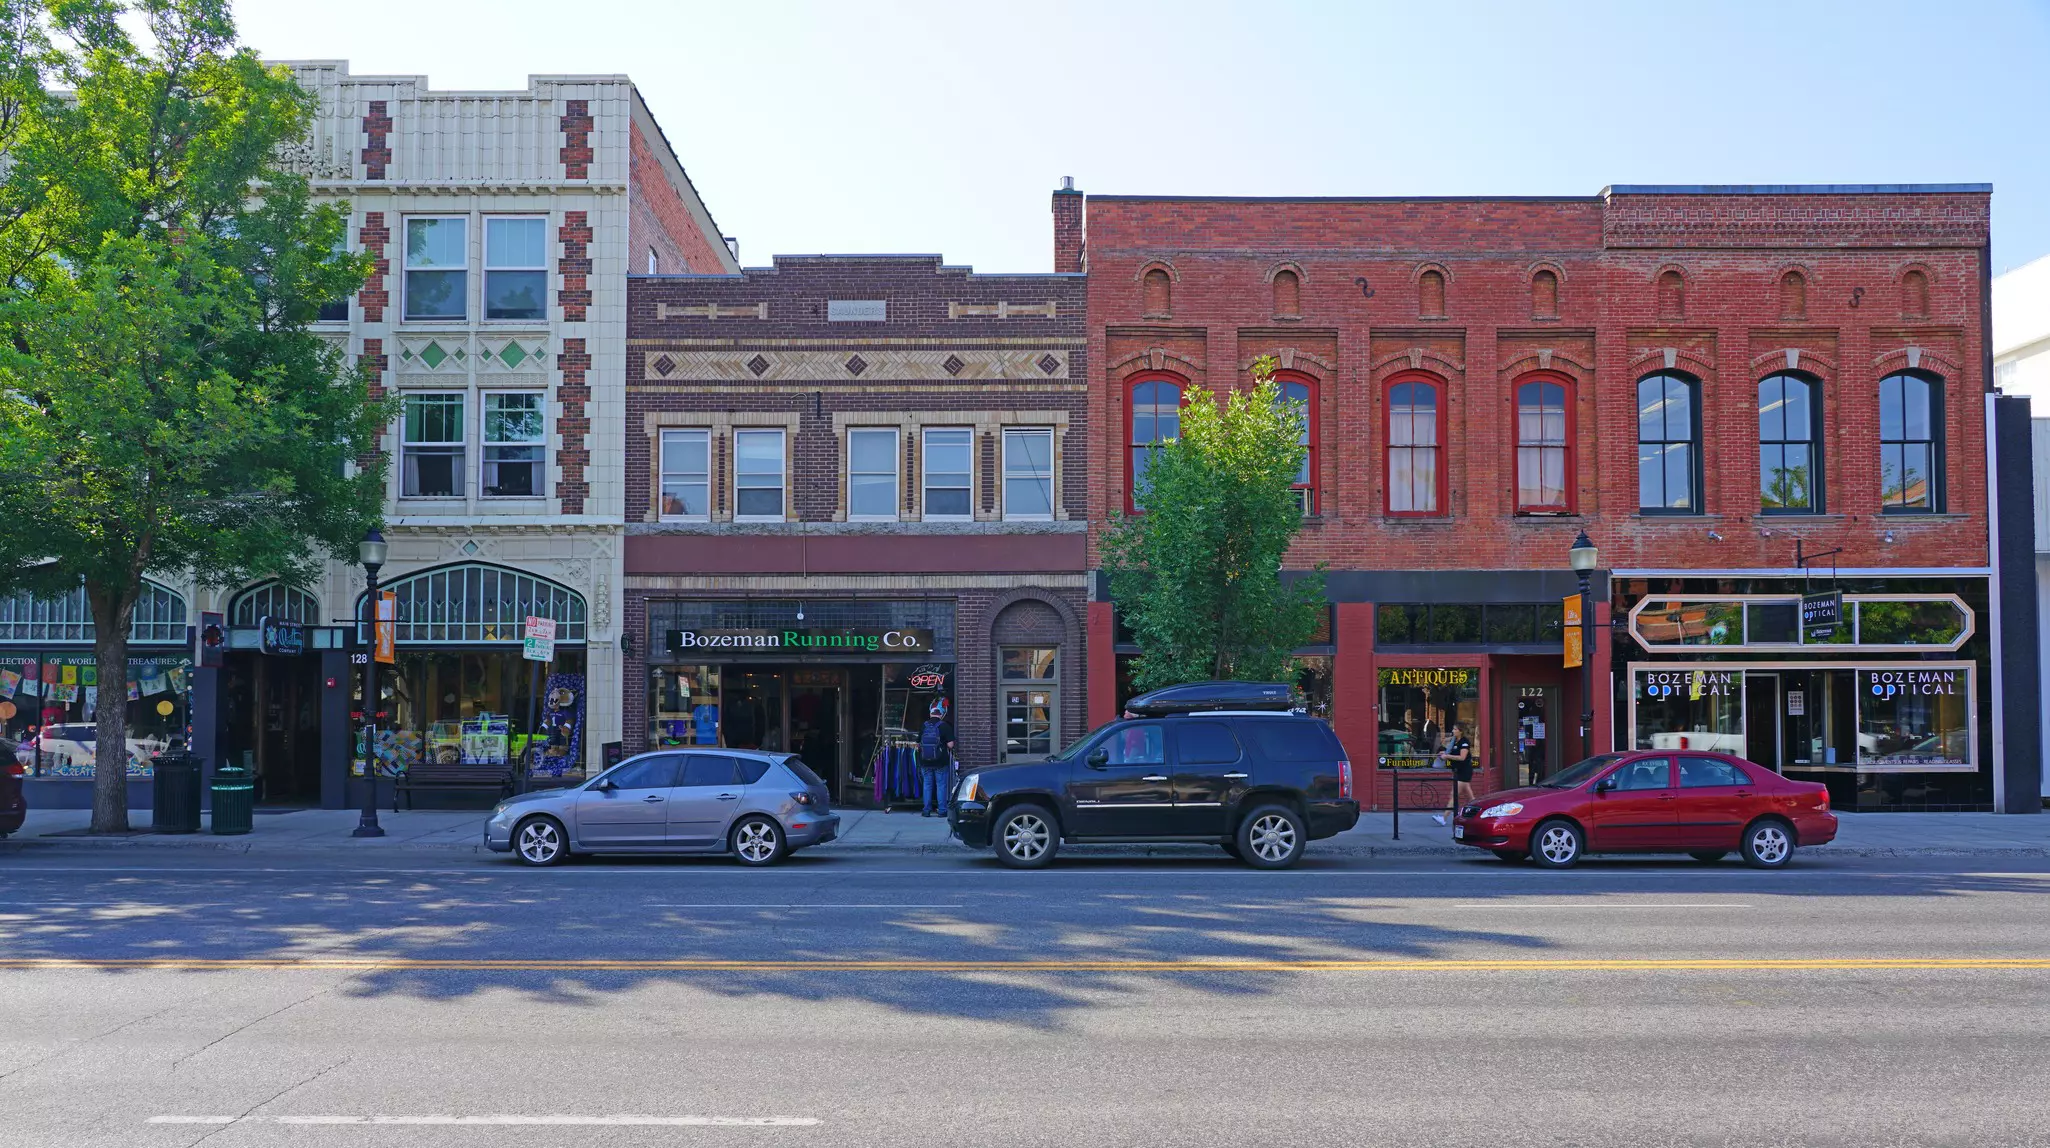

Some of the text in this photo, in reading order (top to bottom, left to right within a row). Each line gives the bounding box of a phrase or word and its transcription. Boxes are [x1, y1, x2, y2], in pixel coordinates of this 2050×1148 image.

[830, 306, 885, 316] SAUNDERS
[1804, 600, 1835, 610] BOZEMAN
[1804, 609, 1835, 621] OPTICAL
[527, 617, 554, 628] NO PARKING
[527, 639, 533, 648] 2
[680, 631, 920, 651] Bozeman Running Co.
[50, 657, 62, 665] OF
[128, 657, 177, 665] TREASURES
[350, 654, 367, 664] 128
[911, 675, 944, 687] OPEN
[1390, 670, 1468, 685] ANTIQUES
[1648, 673, 1731, 684] BOZEMAN
[1871, 672, 1954, 683] BOZEMAN
[1521, 687, 1544, 697] 122
[1648, 685, 1731, 701] OPTICAL
[1872, 684, 1955, 700] OPTICAL
